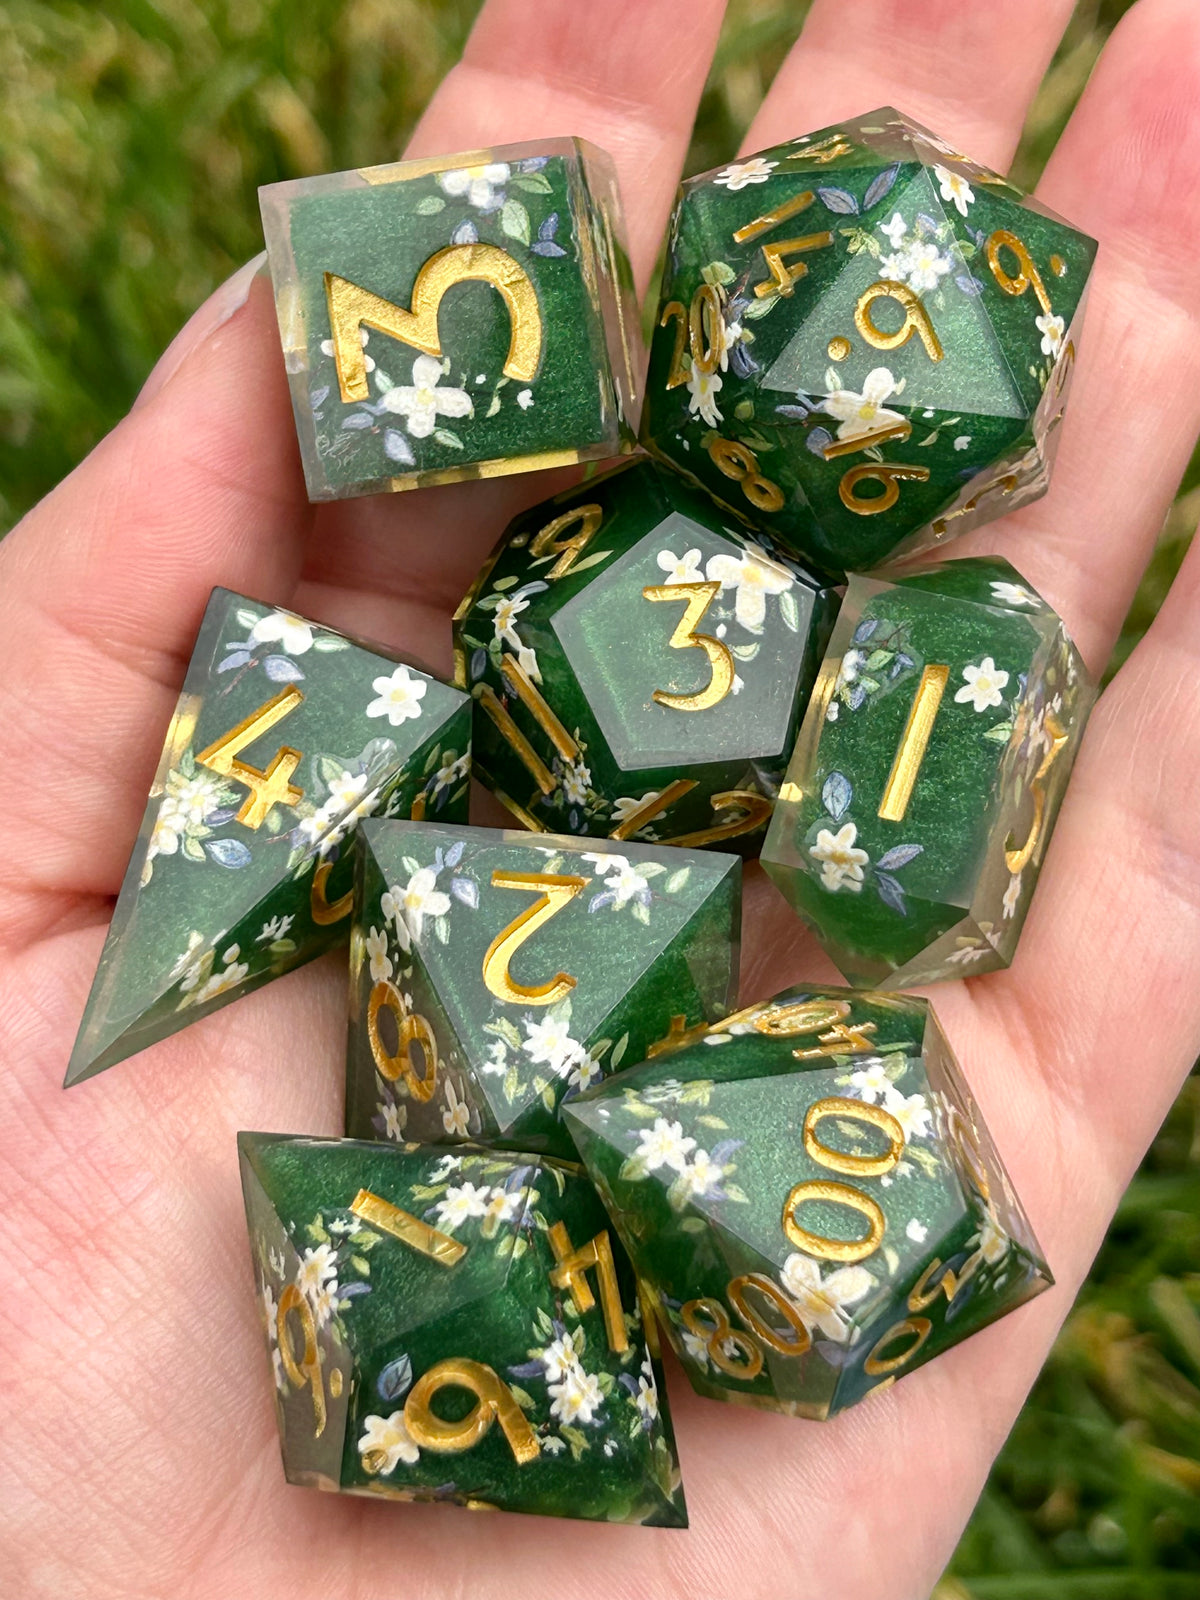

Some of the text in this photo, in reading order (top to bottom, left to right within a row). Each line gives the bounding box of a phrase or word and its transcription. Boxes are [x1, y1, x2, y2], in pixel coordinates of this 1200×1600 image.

[733, 190, 834, 298] 14
[323, 242, 542, 404] 3
[660, 284, 726, 391] 20
[708, 437, 784, 512] 8
[642, 580, 735, 711] 3
[195, 683, 306, 830] 4
[878, 664, 950, 821] 1
[483, 870, 592, 1006] 2
[367, 980, 437, 1103] 8
[349, 1188, 467, 1267] 1
[783, 1096, 905, 1263] 00
[548, 1220, 629, 1353] 4
[680, 1272, 811, 1379] 80
